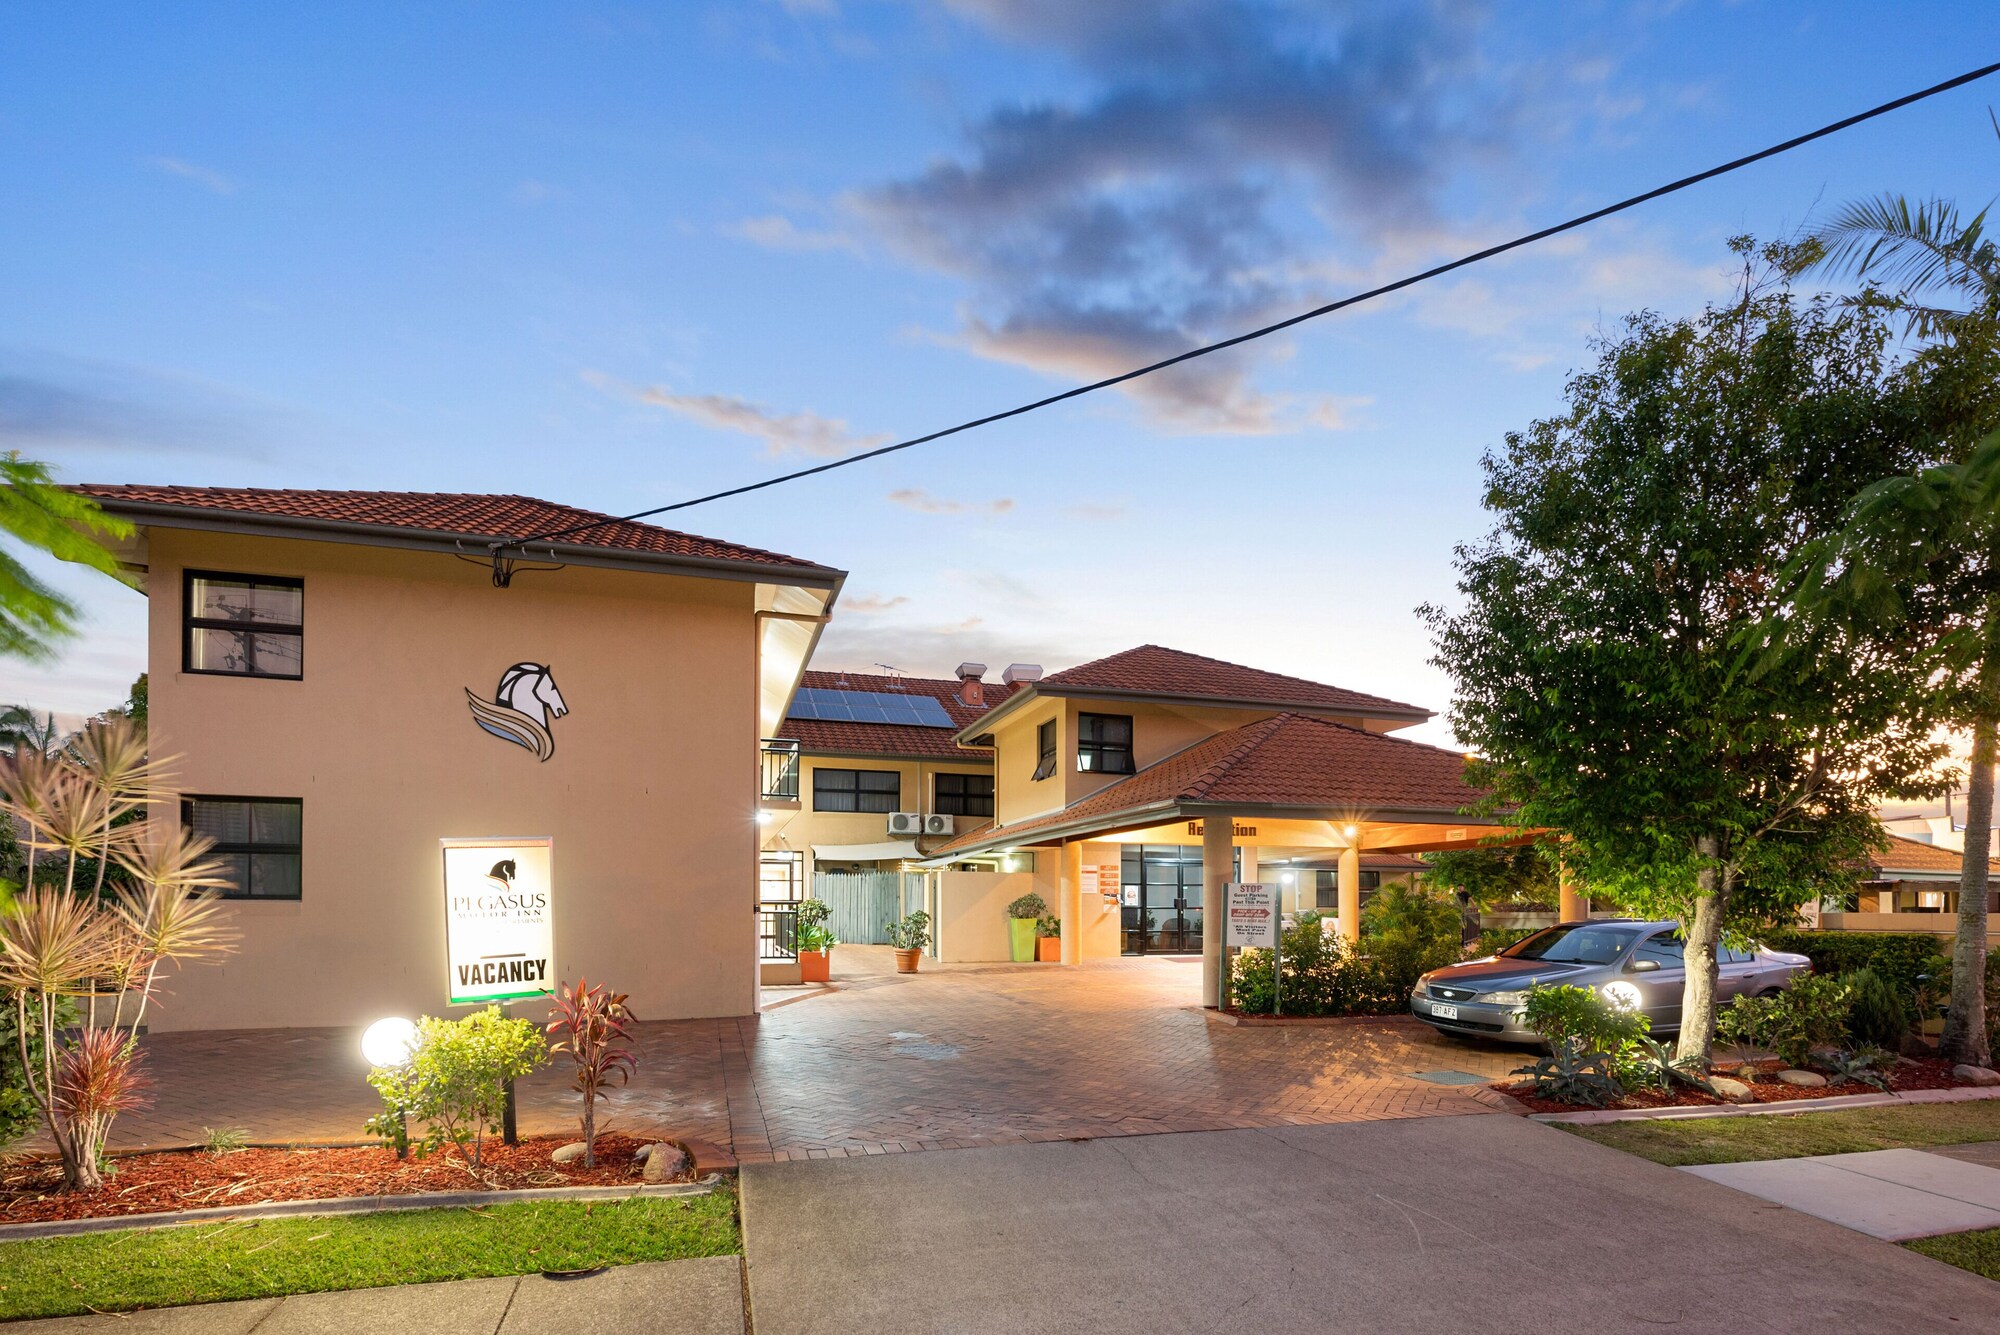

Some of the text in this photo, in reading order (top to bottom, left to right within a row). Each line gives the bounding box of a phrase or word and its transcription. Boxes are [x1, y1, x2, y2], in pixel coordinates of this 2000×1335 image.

[1188, 822, 1257, 836] Retion
[517, 909, 541, 917] INN
[458, 959, 547, 986] VACANCY
